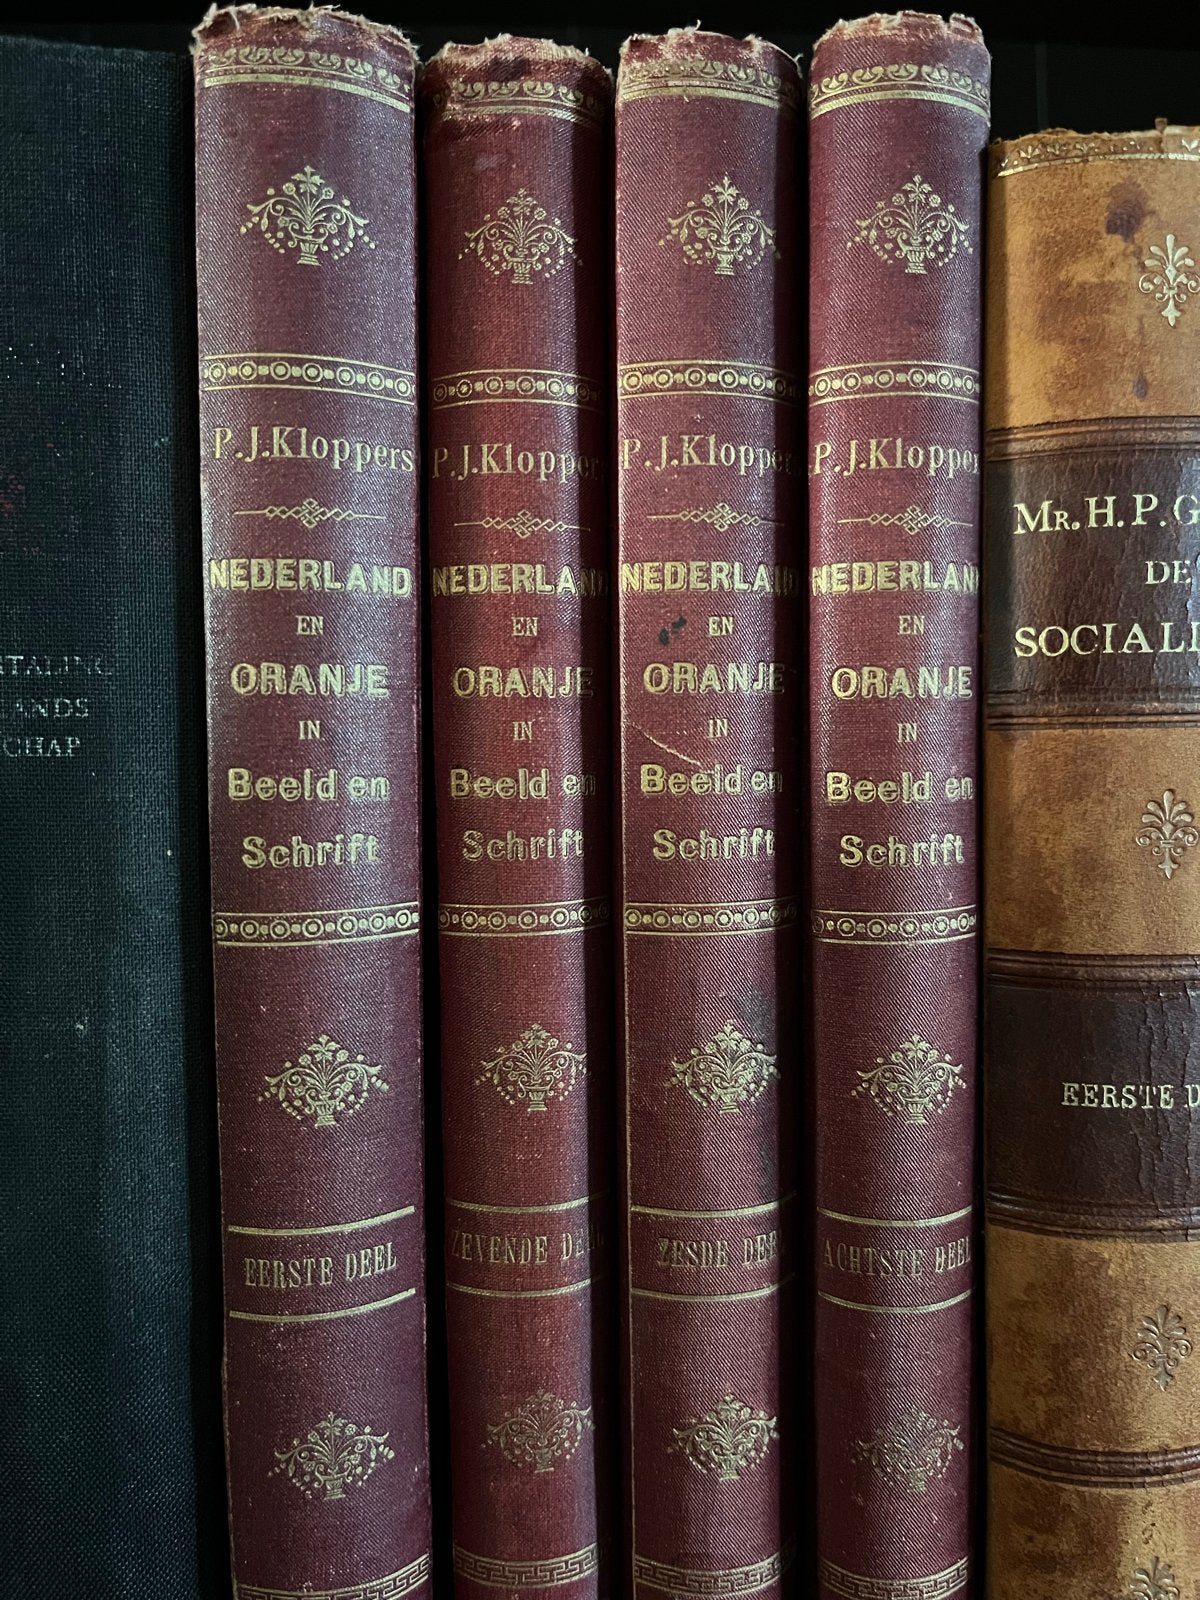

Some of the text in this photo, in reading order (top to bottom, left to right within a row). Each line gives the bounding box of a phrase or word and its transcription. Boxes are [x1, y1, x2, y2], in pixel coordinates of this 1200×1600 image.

[208, 557, 413, 599] NEDERLAND
[811, 560, 980, 596] NEDERLAN
[1145, 560, 1191, 585] DE
[296, 615, 324, 636] EN
[511, 616, 538, 637] EN
[707, 616, 734, 637] EN
[898, 614, 925, 636] EN
[230, 662, 391, 699] ORANJE
[452, 665, 594, 699] ORANJE
[643, 662, 785, 695] ORANJE
[831, 666, 973, 699] ORANJE
[298, 720, 321, 740] IN
[512, 720, 534, 741] IN
[707, 719, 729, 739] IN
[897, 723, 919, 743] IN
[227, 768, 390, 801] Beeld en
[449, 768, 597, 800] Beeld en
[640, 763, 783, 796] Beeld en
[826, 770, 975, 803] Beeld en
[242, 833, 381, 869] Schrift
[462, 828, 585, 862] Schrift
[653, 827, 776, 862] Schrift
[839, 832, 966, 868] Schrift
[1061, 1082, 1175, 1109] EERSTE
[450, 1230, 548, 1264] ZEVENDE
[657, 1230, 779, 1268] ZESDE DEE
[821, 1241, 923, 1276] ACHTSTE
[243, 1241, 397, 1288] EERSTE DEEL
